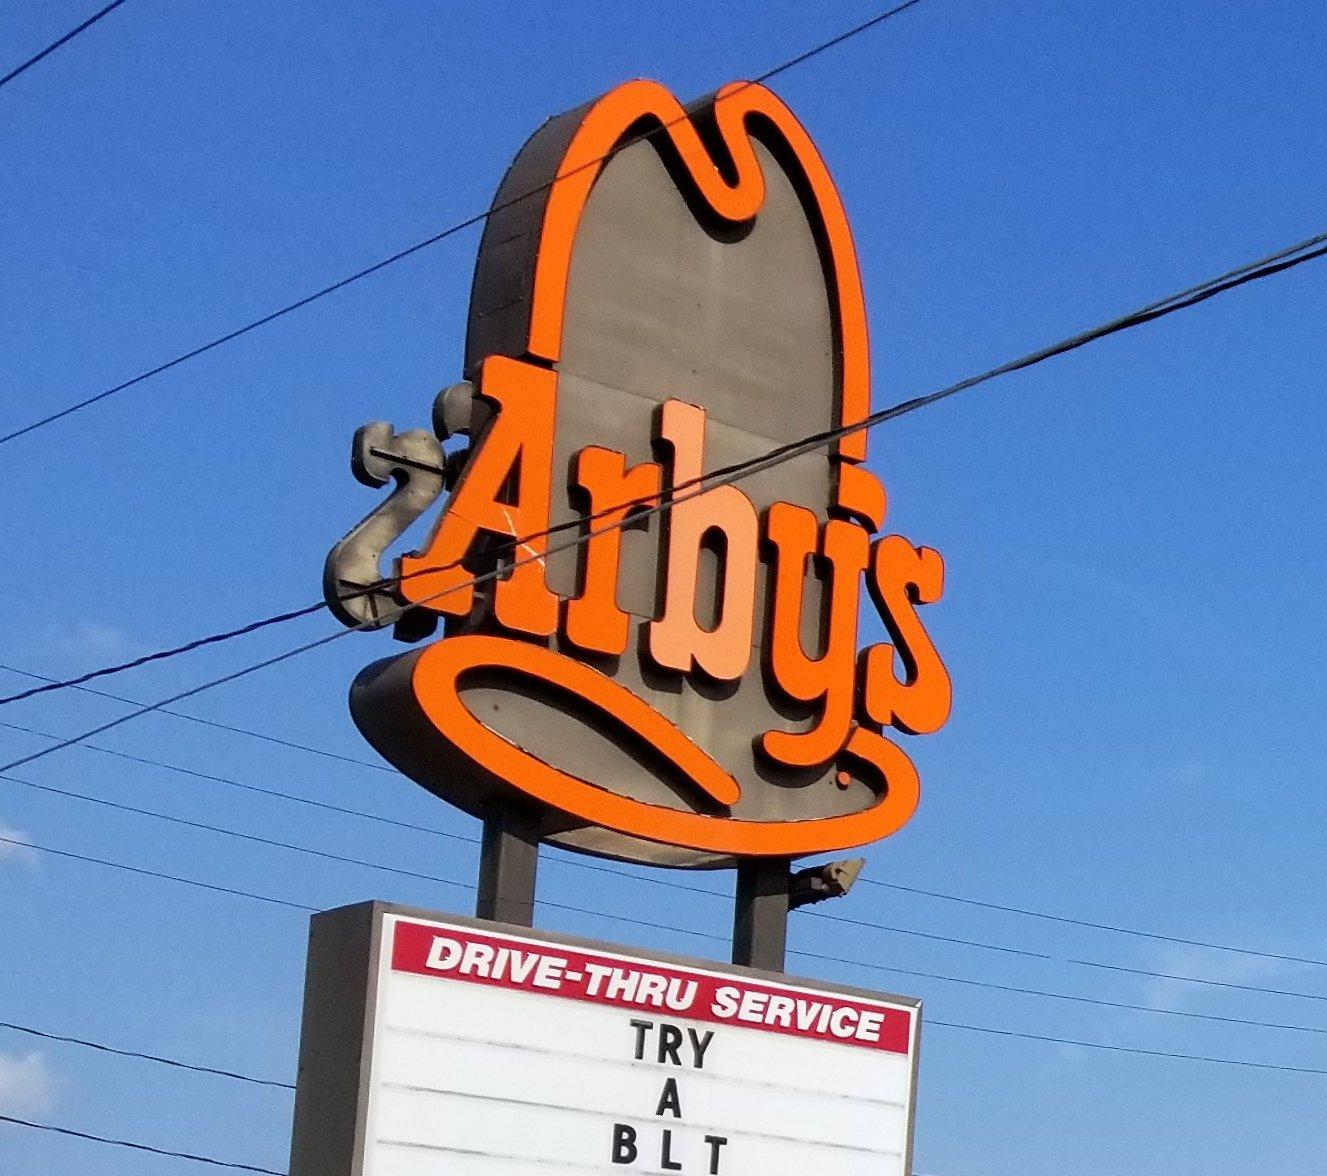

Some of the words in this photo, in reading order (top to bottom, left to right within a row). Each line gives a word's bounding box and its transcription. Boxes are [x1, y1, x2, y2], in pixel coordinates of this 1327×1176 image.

[400, 354, 952, 768] Arby's
[424, 934, 699, 1012] DRIVE-THRU
[711, 985, 885, 1043] SERVICE
[629, 1018, 716, 1069] TRY
[655, 1077, 682, 1119] A
